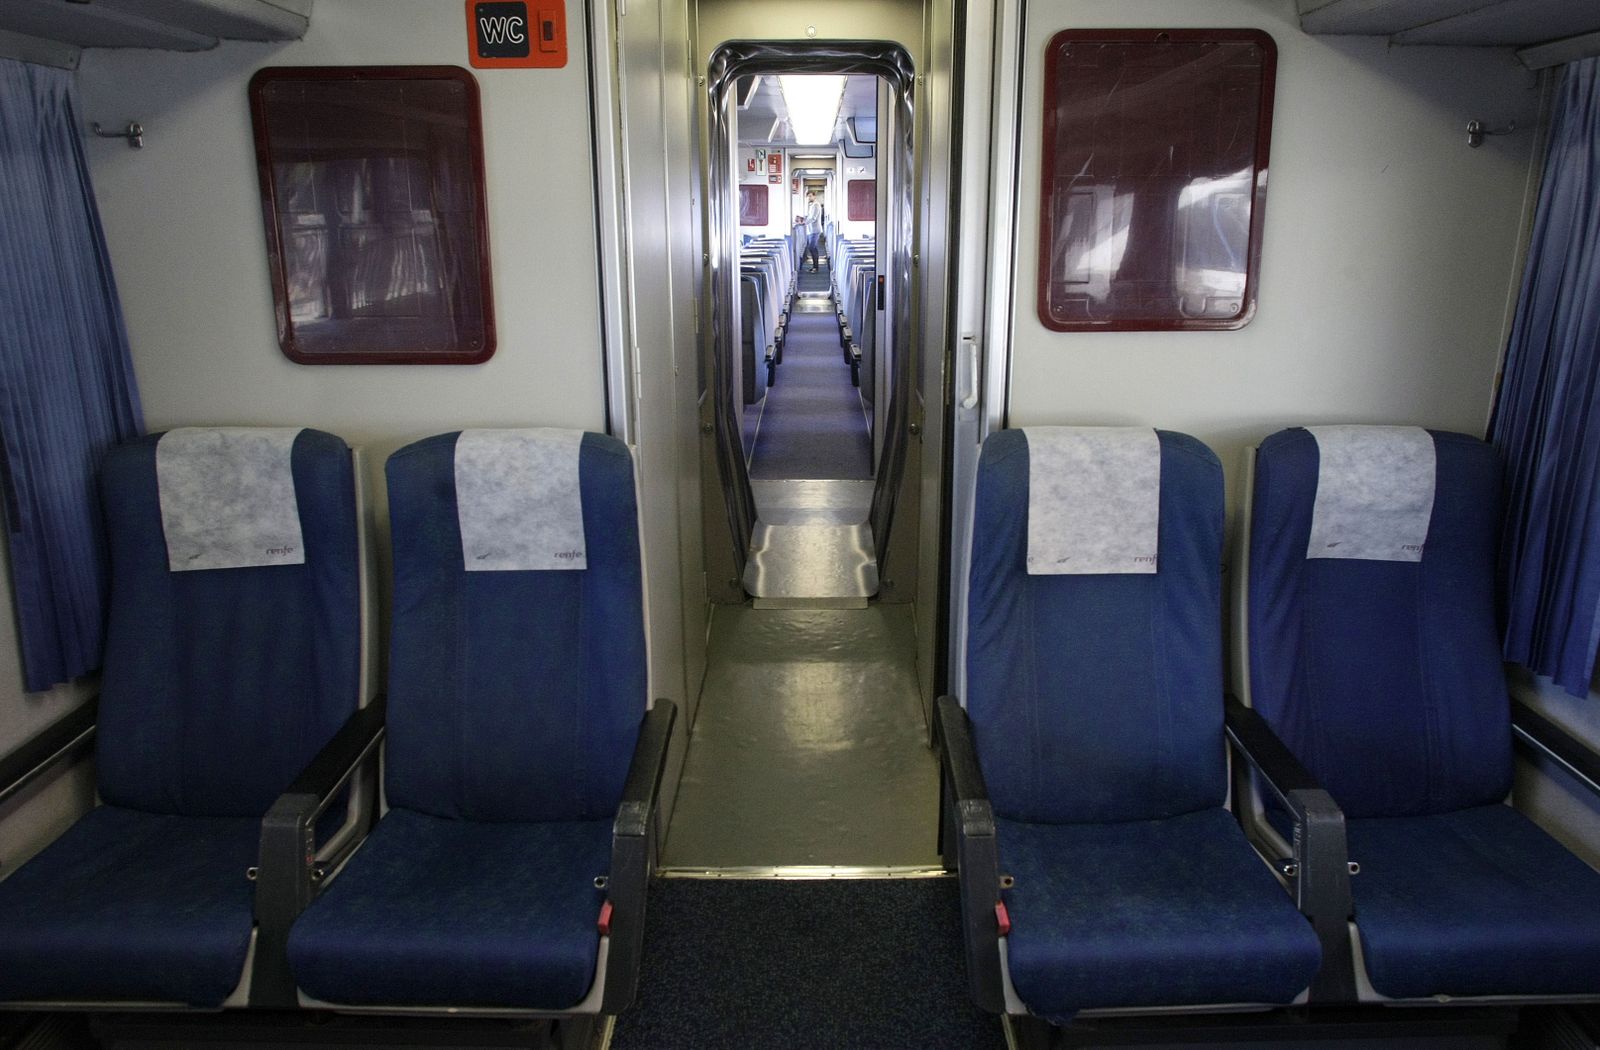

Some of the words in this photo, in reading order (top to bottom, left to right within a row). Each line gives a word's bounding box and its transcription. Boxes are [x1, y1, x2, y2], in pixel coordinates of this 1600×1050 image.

[480, 16, 524, 44] WC
[265, 545, 294, 556] renfe
[553, 549, 583, 561] renfe
[1134, 553, 1157, 565] renf
